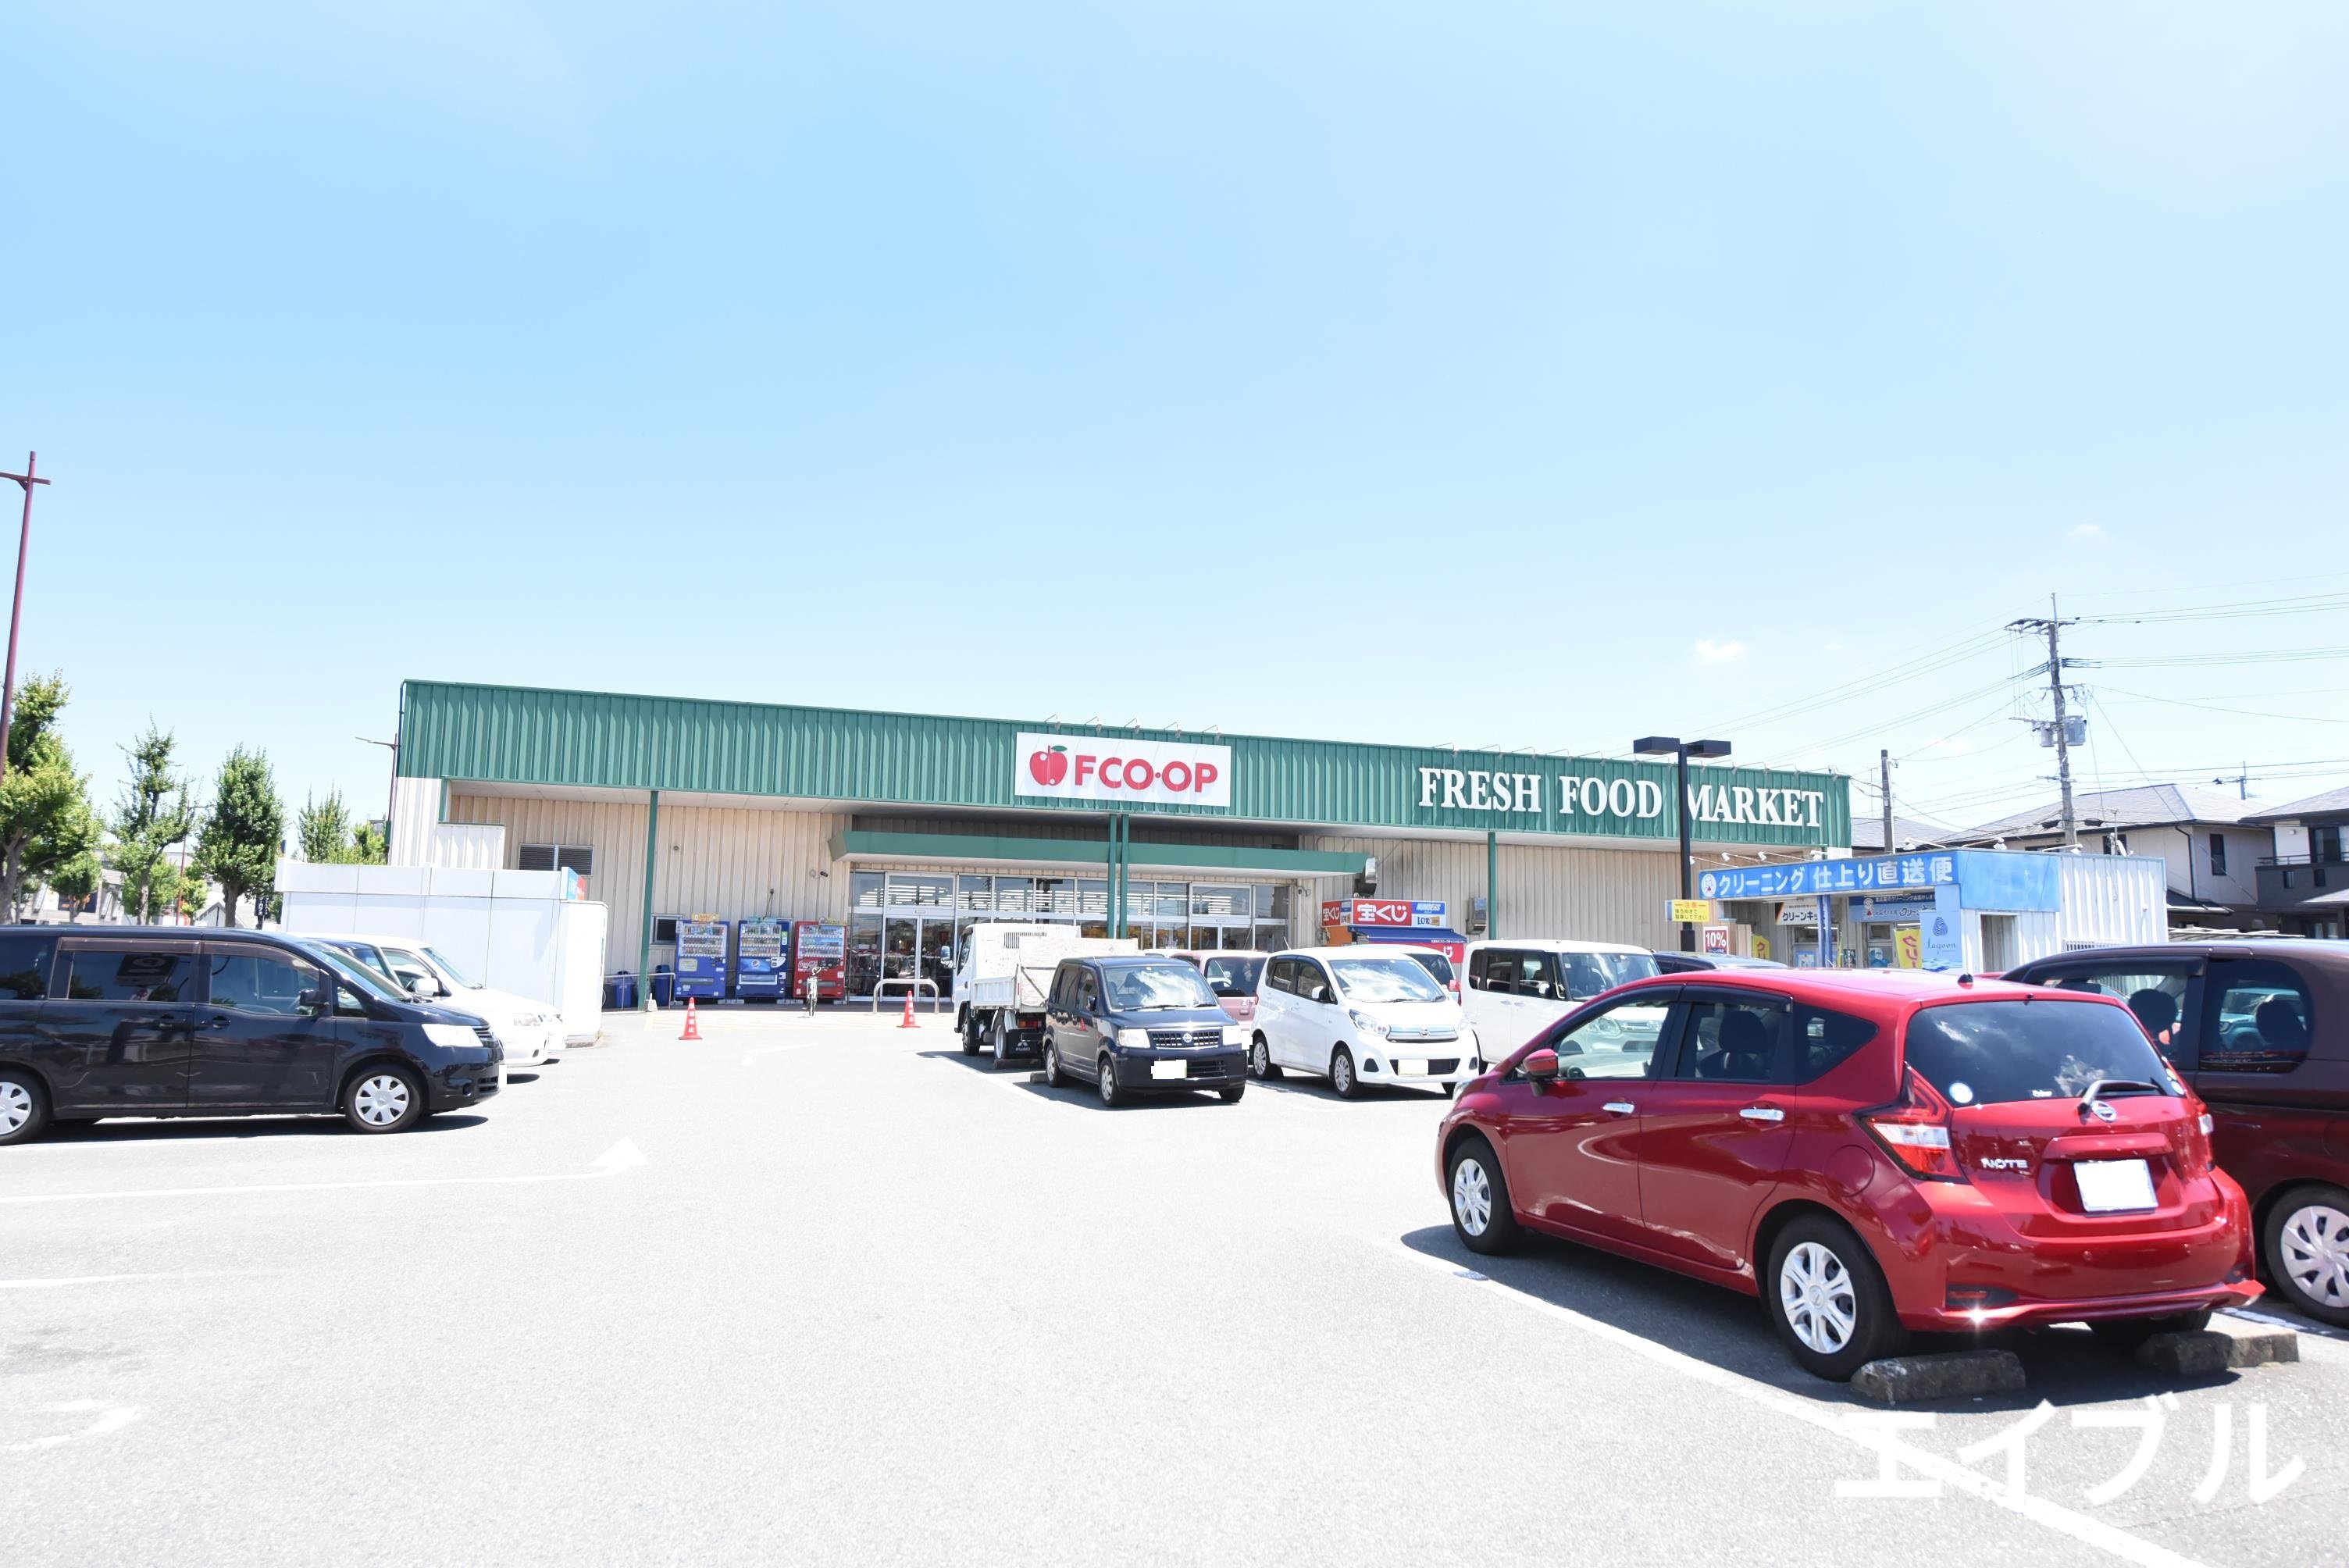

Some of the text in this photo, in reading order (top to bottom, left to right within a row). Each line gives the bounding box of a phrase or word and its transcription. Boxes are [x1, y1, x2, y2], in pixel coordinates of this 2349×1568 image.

[1418, 767, 1824, 828] FRESH FOOD MARKET
[1719, 857, 1953, 896] クリーニング 仕上り直送便
[1323, 907, 1340, 921] 宝くじ
[1356, 903, 1407, 922] 宝くじ
[1706, 932, 1727, 947] 10%
[1980, 1158, 2029, 1169] NOTE
